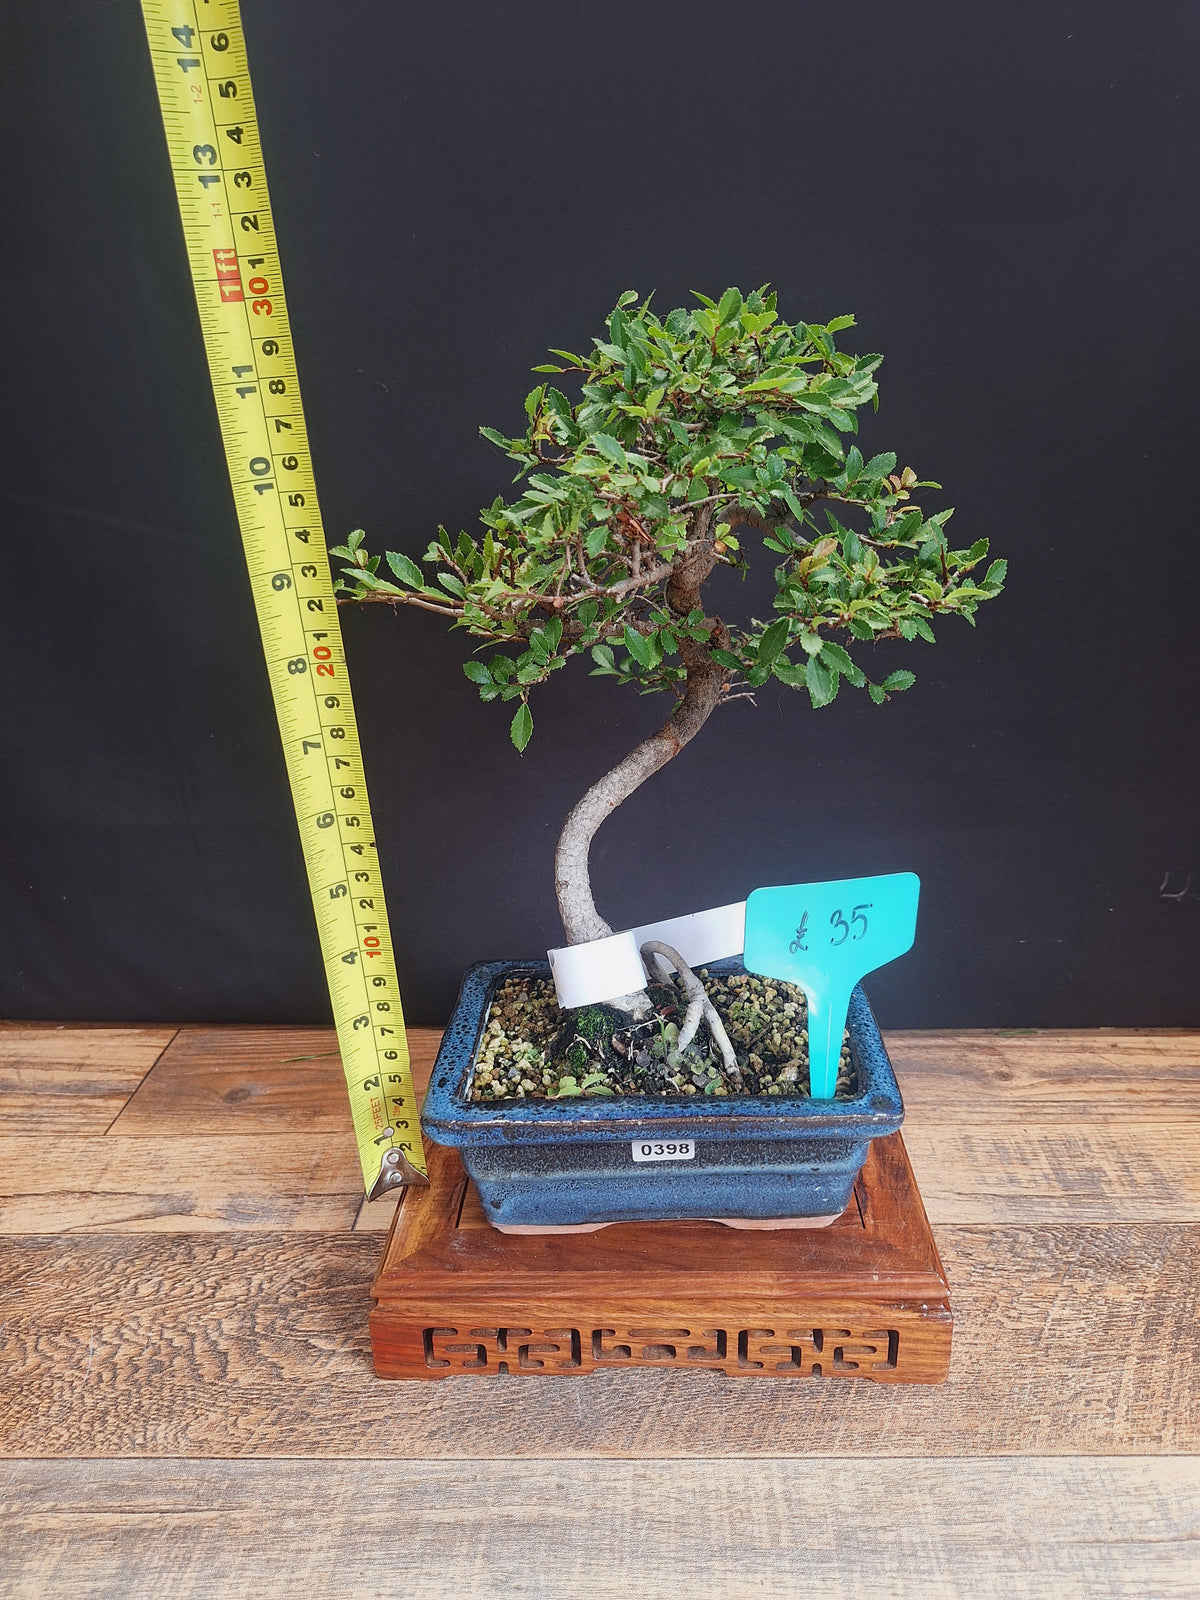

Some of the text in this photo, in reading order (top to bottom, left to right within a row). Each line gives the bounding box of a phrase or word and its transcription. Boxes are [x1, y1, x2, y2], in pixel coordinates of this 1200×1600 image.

[171, 24, 200, 73] 14
[211, 33, 229, 52] 6
[219, 81, 237, 98] 5
[226, 126, 244, 144] 4
[193, 144, 220, 189] 13
[234, 171, 252, 188] 3
[241, 214, 260, 232] 2
[248, 258, 265, 269] 1
[248, 277, 273, 316] 30
[262, 340, 279, 356] 9
[232, 365, 257, 399] 11
[269, 379, 286, 395] 8
[275, 419, 292, 433] 7
[282, 456, 299, 471] 6
[249, 457, 275, 496] 10
[288, 493, 305, 507] 5
[295, 529, 310, 543] 4
[301, 565, 318, 578] 3
[271, 573, 292, 591] 9
[307, 599, 324, 612] 2
[313, 632, 329, 641] 1
[288, 658, 307, 675] 8
[313, 646, 336, 677] 20
[324, 696, 340, 709] 9
[330, 727, 345, 739] 8
[302, 740, 321, 755] 7
[335, 758, 351, 770] 7
[340, 787, 355, 799] 6
[317, 813, 335, 829] 6
[346, 816, 361, 827] 5
[351, 844, 364, 856] 4
[355, 872, 369, 883] 3
[330, 883, 348, 900] 5
[360, 898, 374, 909] 2
[830, 903, 873, 946] 35
[364, 936, 382, 958] 10
[342, 951, 358, 965] 4
[376, 1001, 391, 1012] 8
[353, 1015, 370, 1031] 3
[381, 1027, 394, 1037] 7
[363, 1076, 380, 1092] 2
[389, 1074, 402, 1083] 5
[392, 1097, 405, 1107] 4
[396, 1120, 409, 1129] 3
[399, 1142, 413, 1152] 2
[641, 1143, 690, 1156] 0398
